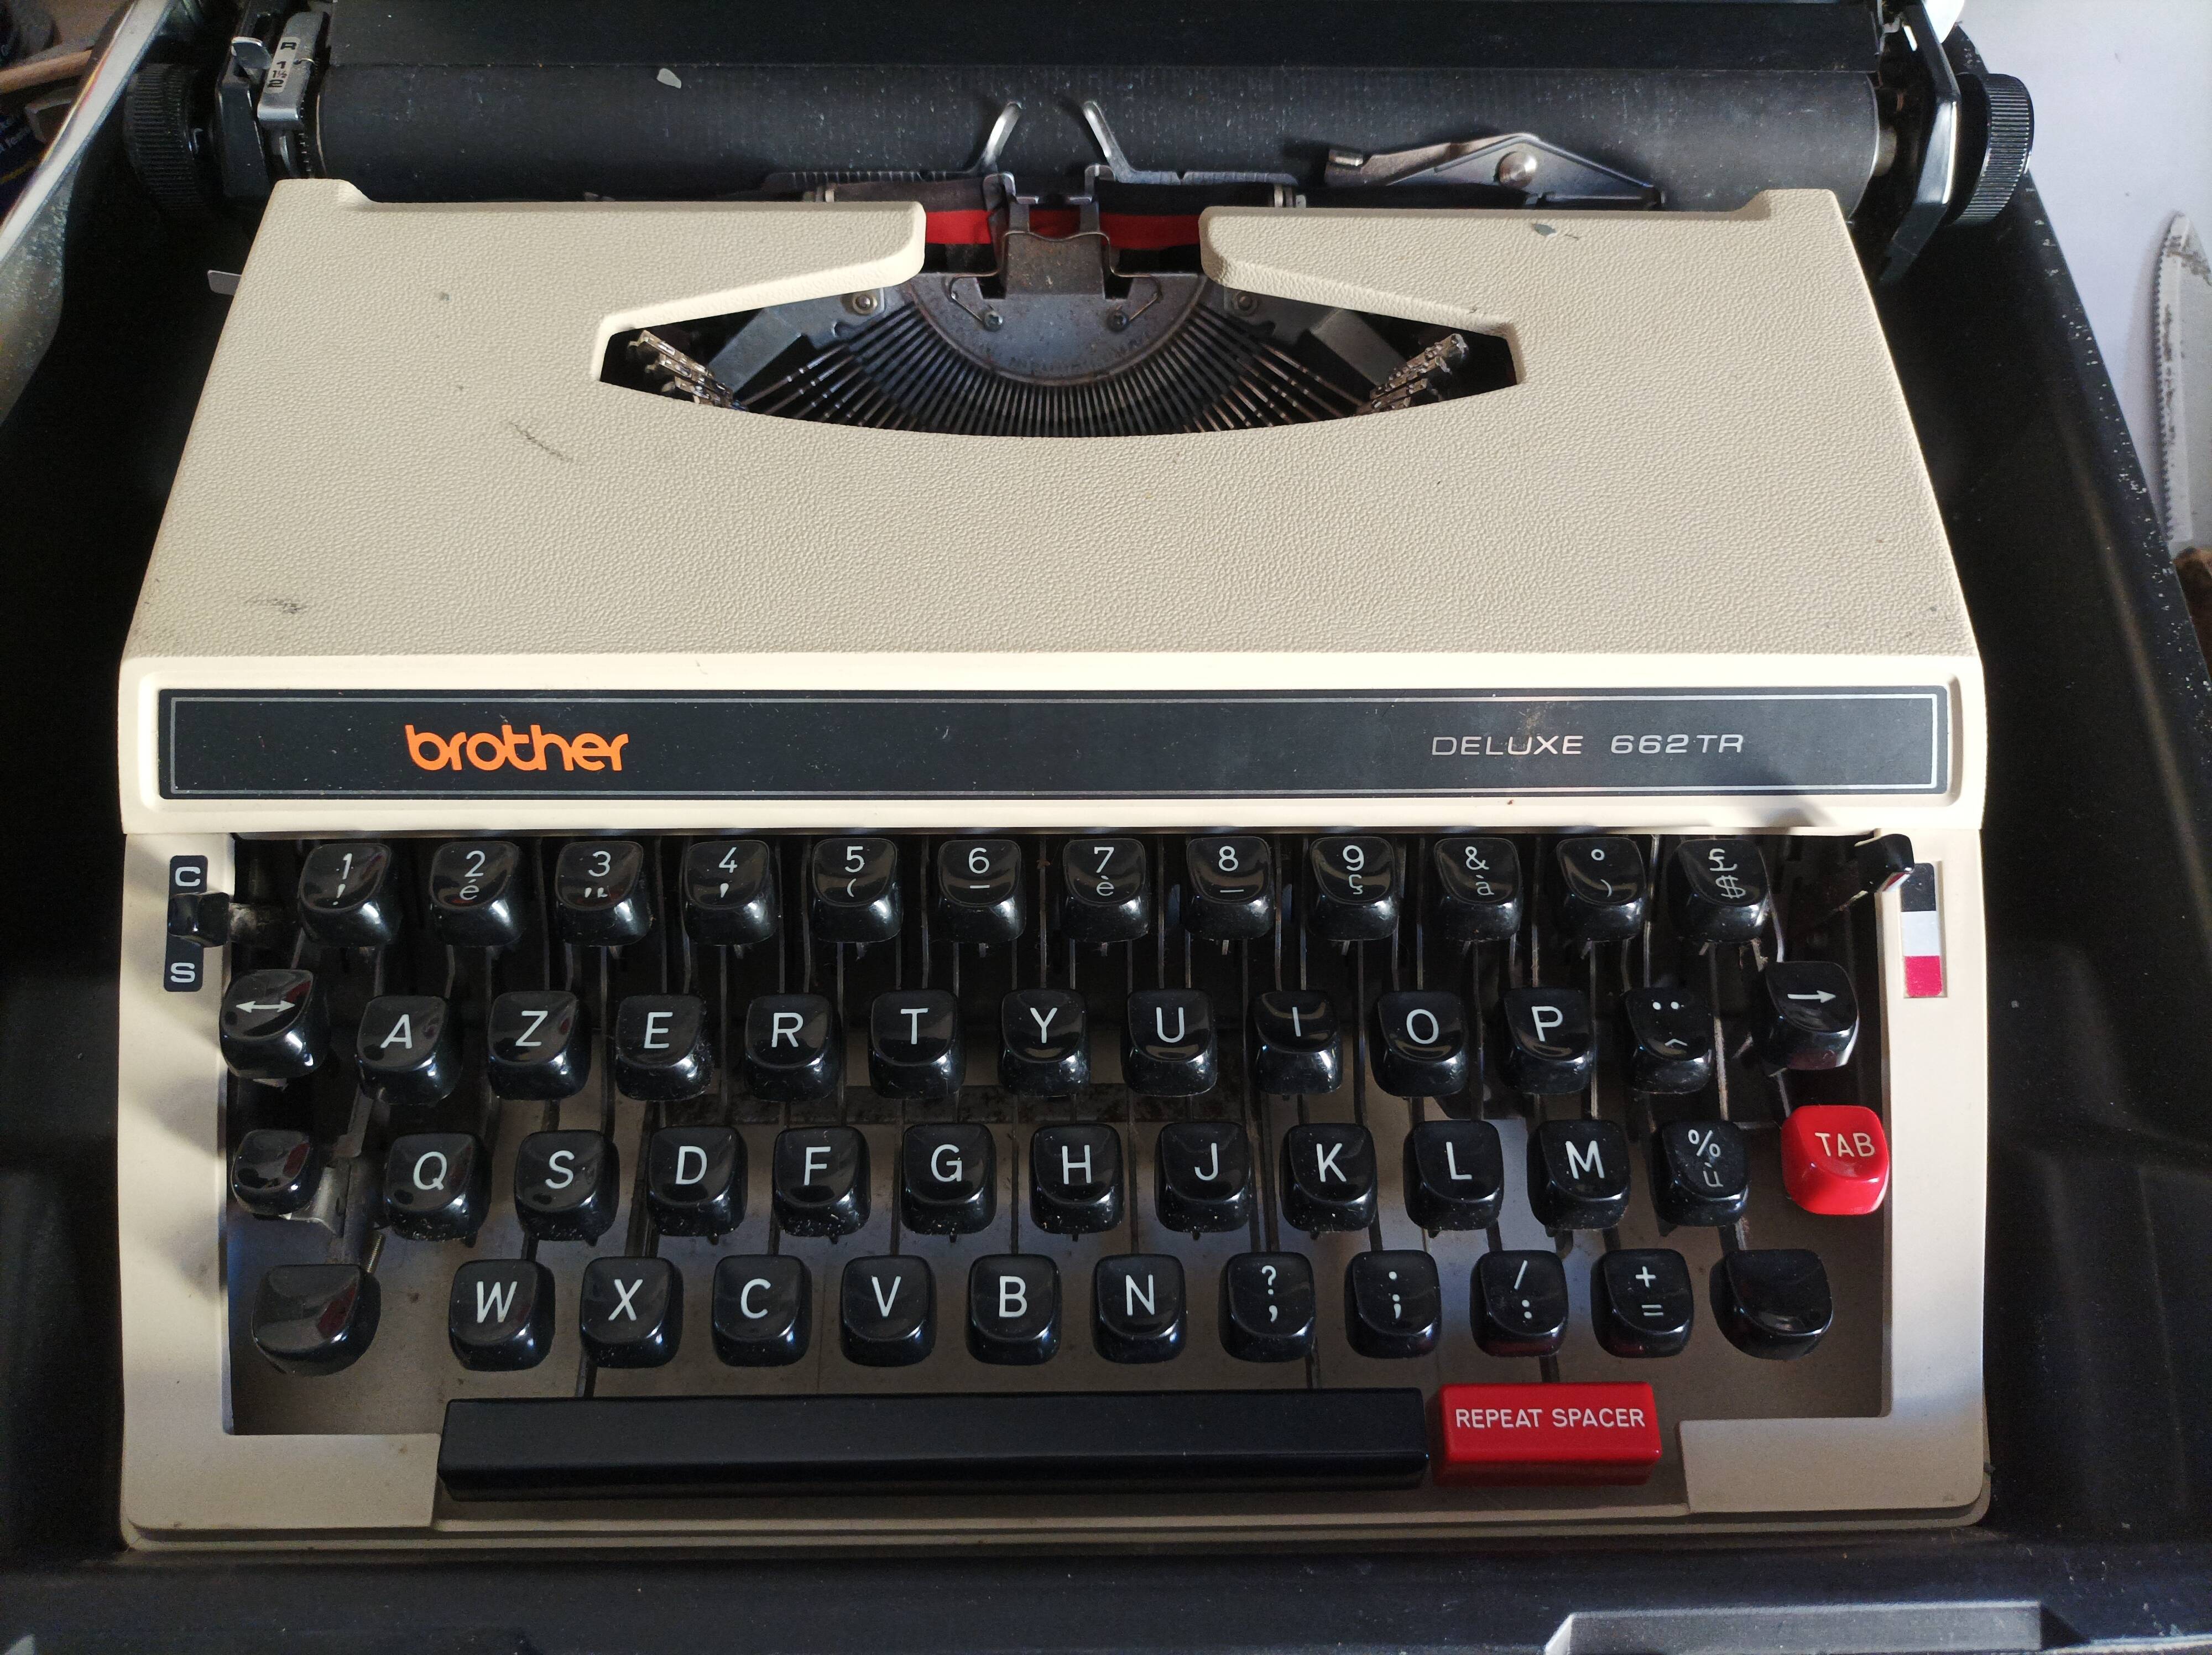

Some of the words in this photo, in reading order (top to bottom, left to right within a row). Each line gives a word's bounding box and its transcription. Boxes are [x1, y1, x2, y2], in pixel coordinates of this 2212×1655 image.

[268, 79, 284, 88] 2
[404, 724, 629, 771] brother
[1431, 735, 1584, 756] DELUXE
[1610, 734, 1744, 754] 662TR
[342, 853, 352, 879] 1
[465, 850, 486, 877] 2
[588, 851, 611, 877] 3
[718, 847, 738, 873] 4
[844, 846, 865, 873] 5
[968, 847, 990, 874] 6
[1094, 846, 1114, 873] 7
[1218, 846, 1239, 872] 8
[1342, 845, 1364, 871] 9
[1465, 846, 1489, 870] &
[175, 866, 201, 887] C
[460, 878, 479, 901] é
[847, 878, 857, 897] (
[1096, 875, 1114, 896] è
[1600, 879, 1612, 897] )
[1715, 875, 1746, 899] $
[333, 883, 346, 905] !
[170, 962, 196, 983] S
[380, 1014, 413, 1049] A
[515, 1010, 548, 1047] Z
[644, 1012, 673, 1049] E
[771, 1012, 804, 1048] R
[900, 1008, 928, 1045] T
[1030, 1007, 1058, 1043] Y
[1156, 1007, 1185, 1043] U
[1292, 1007, 1301, 1037] I
[1406, 1008, 1439, 1044] O
[1531, 1006, 1563, 1042] P
[1688, 1129, 1720, 1157] %
[1814, 1132, 1876, 1158] TAB
[413, 1151, 447, 1190] Q
[545, 1150, 575, 1189] S
[675, 1146, 707, 1185] D
[804, 1146, 831, 1185] F
[931, 1144, 962, 1182] G
[1062, 1144, 1092, 1185] H
[1194, 1143, 1218, 1180] J
[1316, 1143, 1347, 1182] K
[1446, 1141, 1472, 1180] L
[1565, 1140, 1604, 1179] M
[1261, 1265, 1276, 1295] ?
[1514, 1260, 1528, 1289] /
[1635, 1266, 1656, 1287] +
[477, 1281, 518, 1323] W
[608, 1279, 643, 1321] X
[740, 1278, 771, 1319] C
[871, 1275, 901, 1316] V
[999, 1276, 1027, 1318] B
[1125, 1274, 1155, 1315] N
[1521, 1299, 1532, 1319] :
[1641, 1304, 1664, 1316] =
[1455, 1408, 1543, 1428] REPEAT
[1552, 1408, 1646, 1428] SPACER
